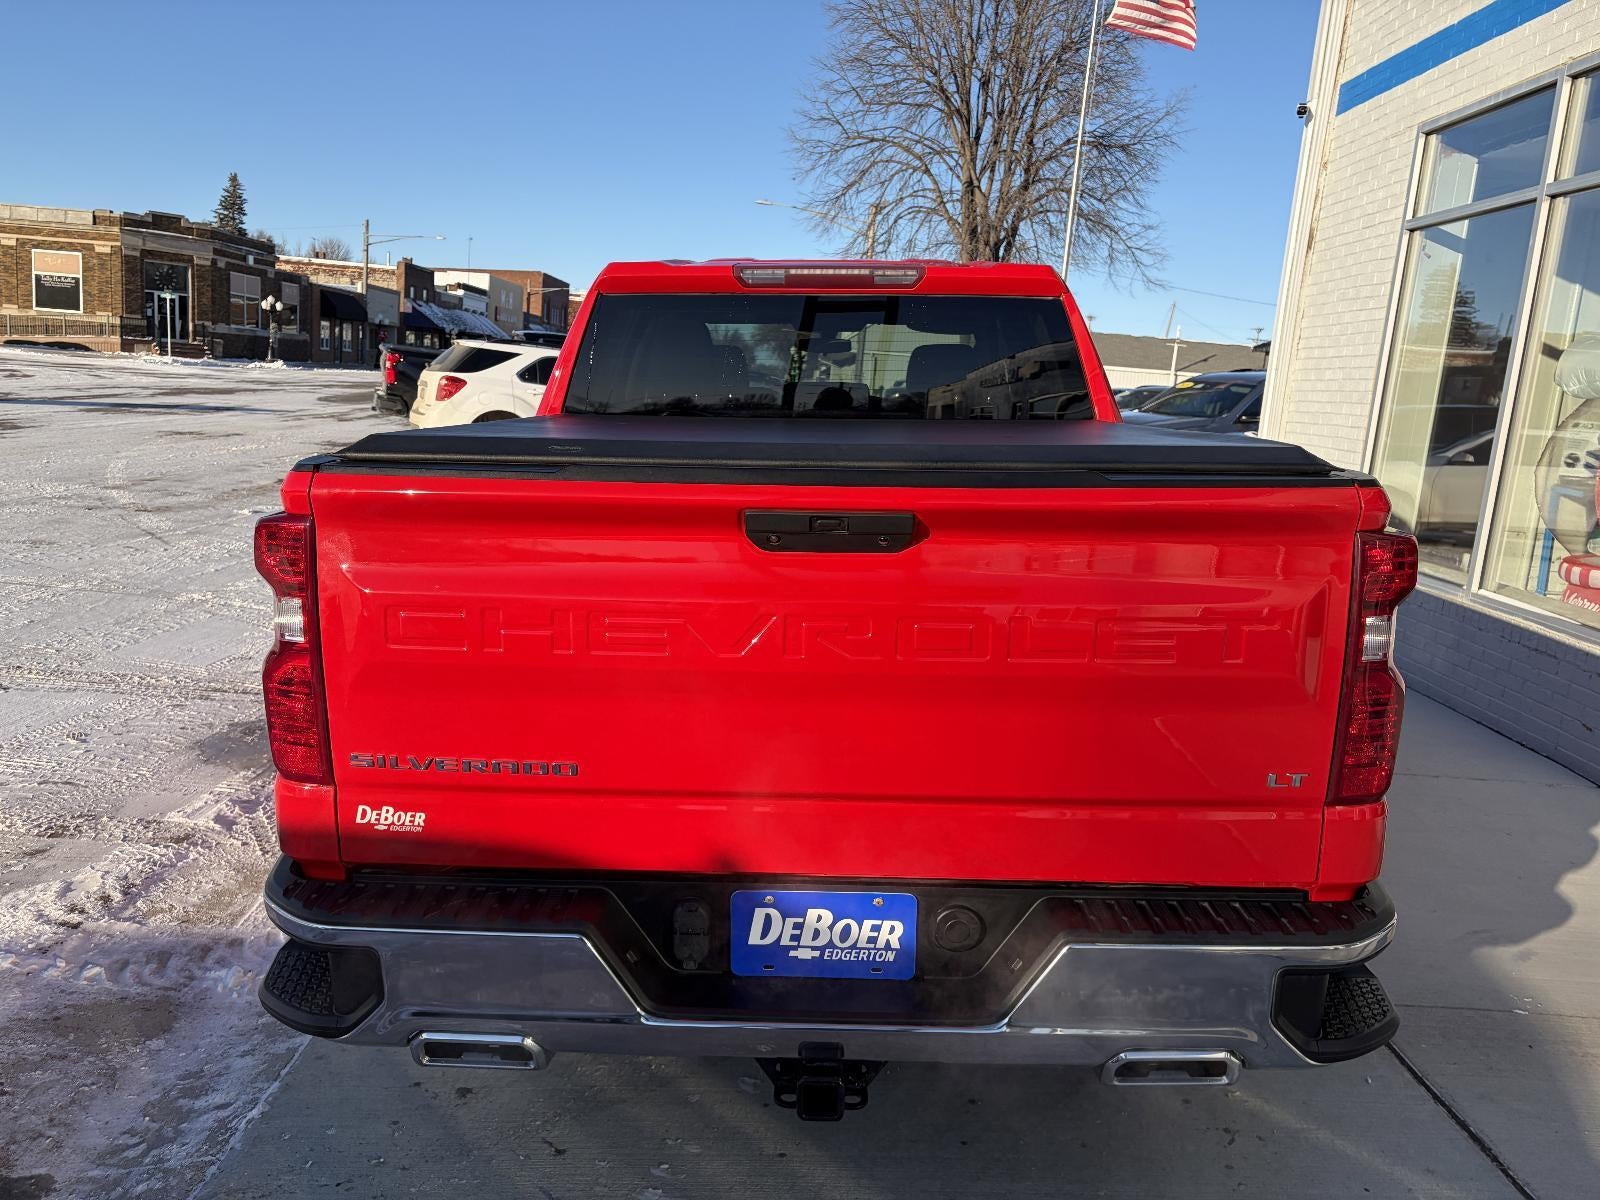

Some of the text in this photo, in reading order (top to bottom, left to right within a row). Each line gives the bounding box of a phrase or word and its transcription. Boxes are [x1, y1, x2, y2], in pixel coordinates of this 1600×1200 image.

[383, 606, 1275, 665] CHEVROLET
[349, 752, 579, 776] SILVERADO
[1266, 772, 1309, 788] LT
[389, 824, 423, 833] EDGERTON
[823, 948, 896, 962] EDGERTON
